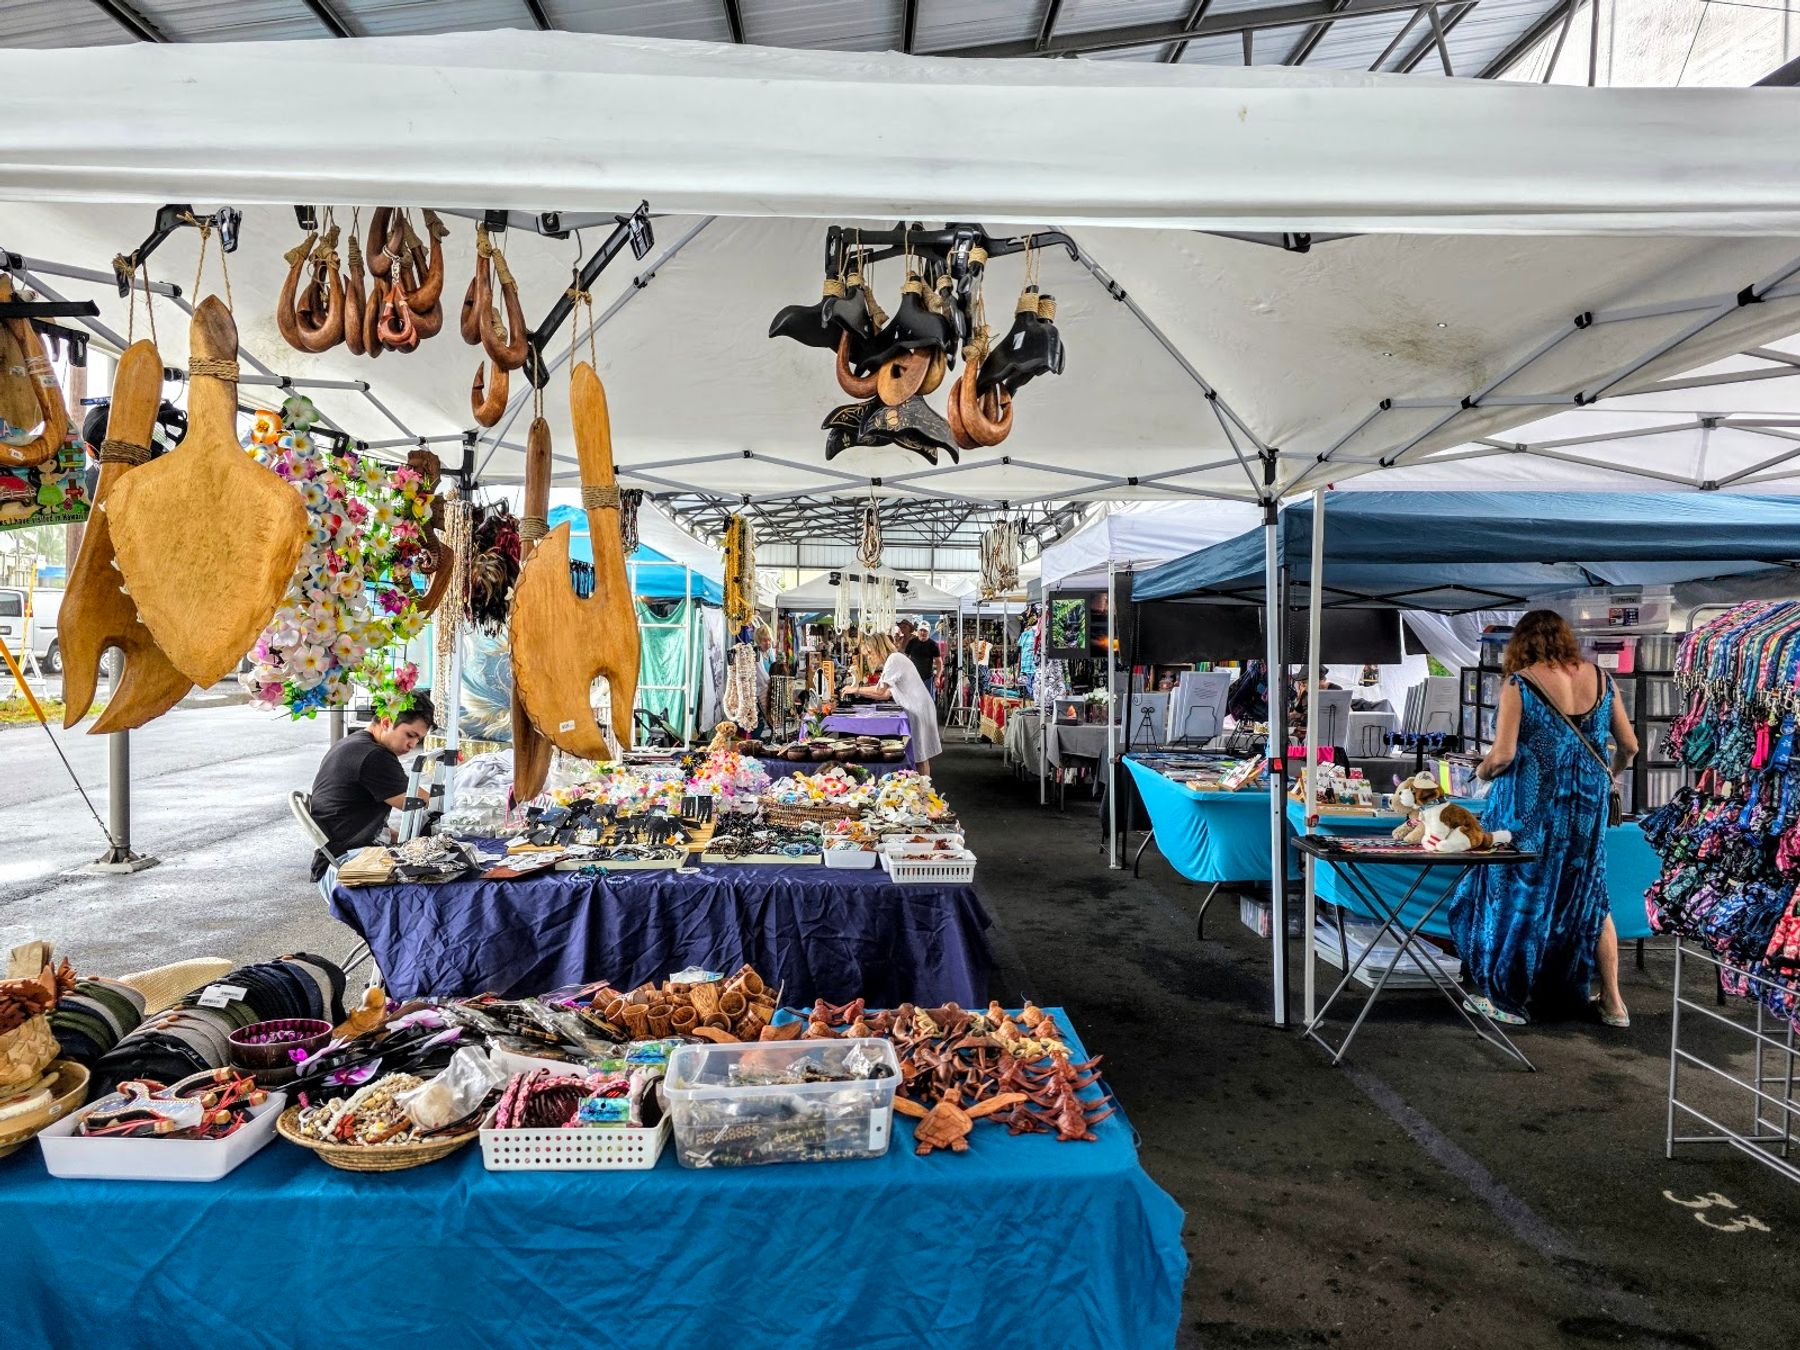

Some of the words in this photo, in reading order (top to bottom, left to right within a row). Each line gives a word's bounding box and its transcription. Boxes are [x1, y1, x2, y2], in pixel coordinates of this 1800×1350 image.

[14, 516, 30, 525] have
[32, 514, 53, 523] visited
[63, 512, 85, 521] Hawaii
